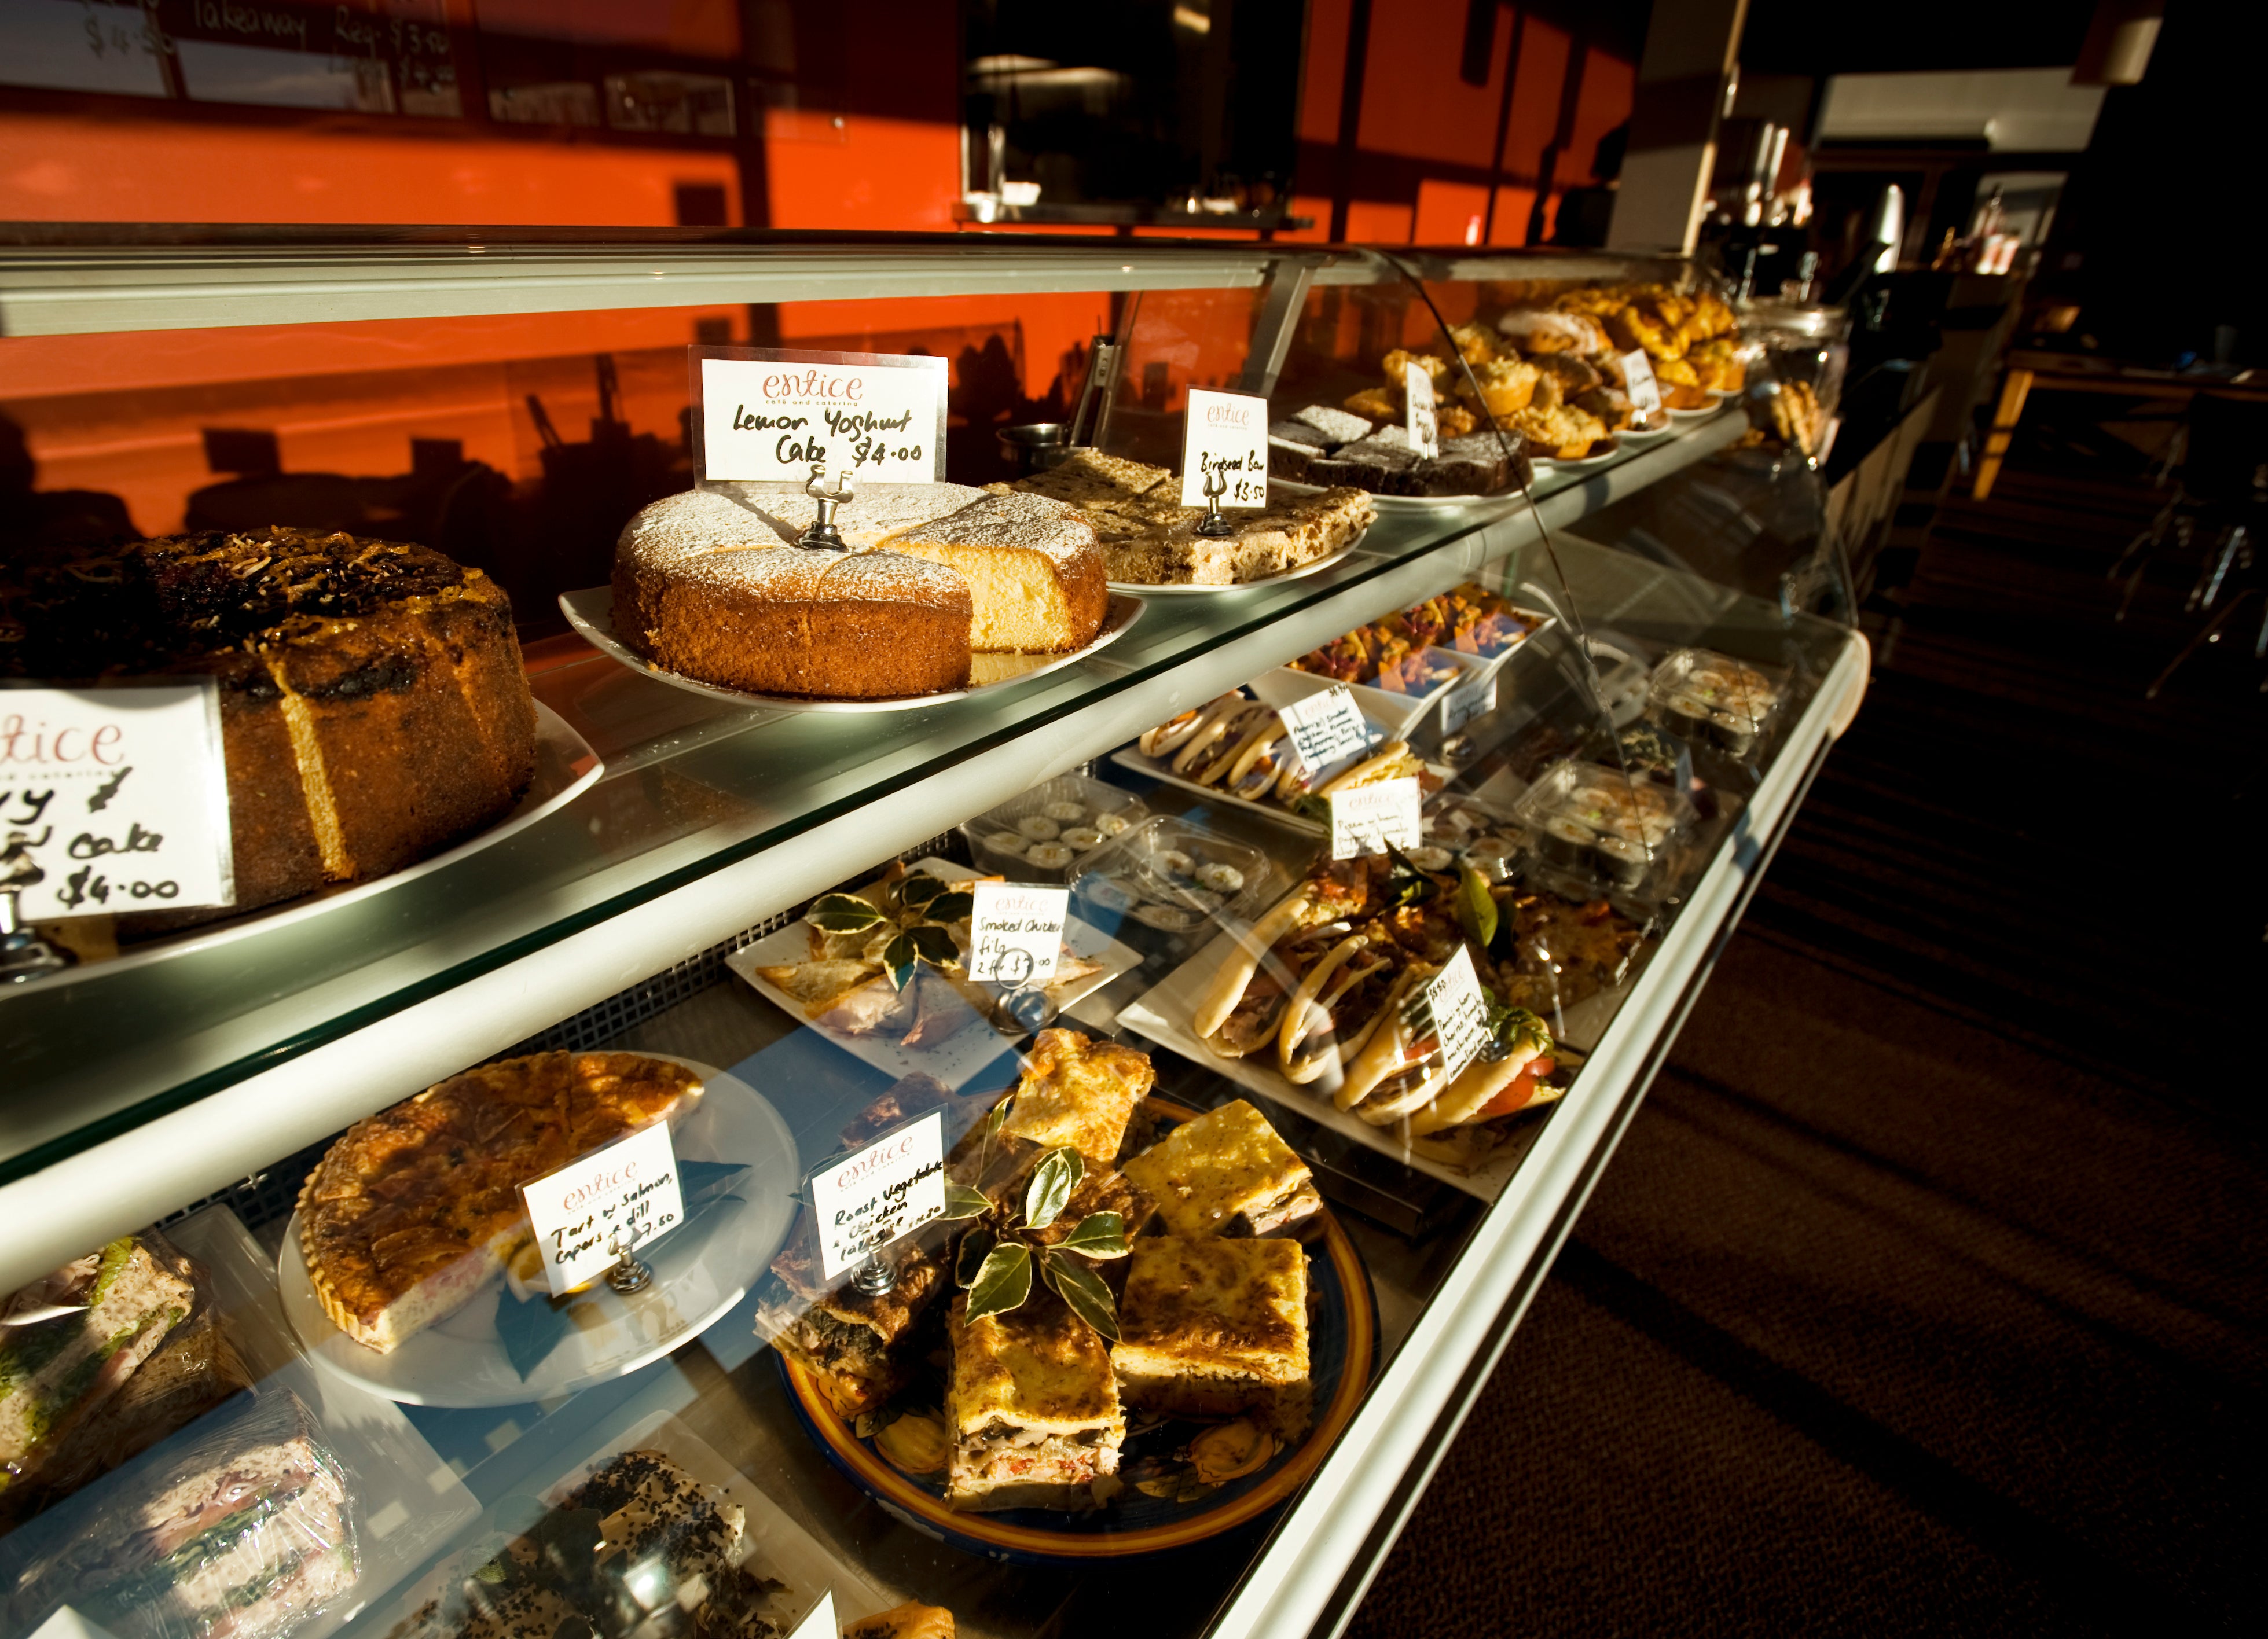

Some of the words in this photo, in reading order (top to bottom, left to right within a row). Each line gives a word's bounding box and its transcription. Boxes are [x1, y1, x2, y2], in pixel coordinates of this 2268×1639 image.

[762, 369, 863, 400] entice
[733, 405, 808, 431] Lemon
[1207, 402, 1250, 426] entice
[776, 435, 827, 464] Cake
[852, 436, 922, 468] $4.00
[1234, 478, 1264, 503] $3.50
[57, 865, 179, 910] $4.00
[995, 895, 1048, 912] entice
[978, 916, 1023, 932] Smoked
[977, 962, 985, 974] 2
[838, 1137, 913, 1188] entice
[563, 1162, 637, 1210] entice
[626, 1200, 649, 1226] dill
[835, 1197, 878, 1228] Roast
[551, 1215, 594, 1248] Tart
